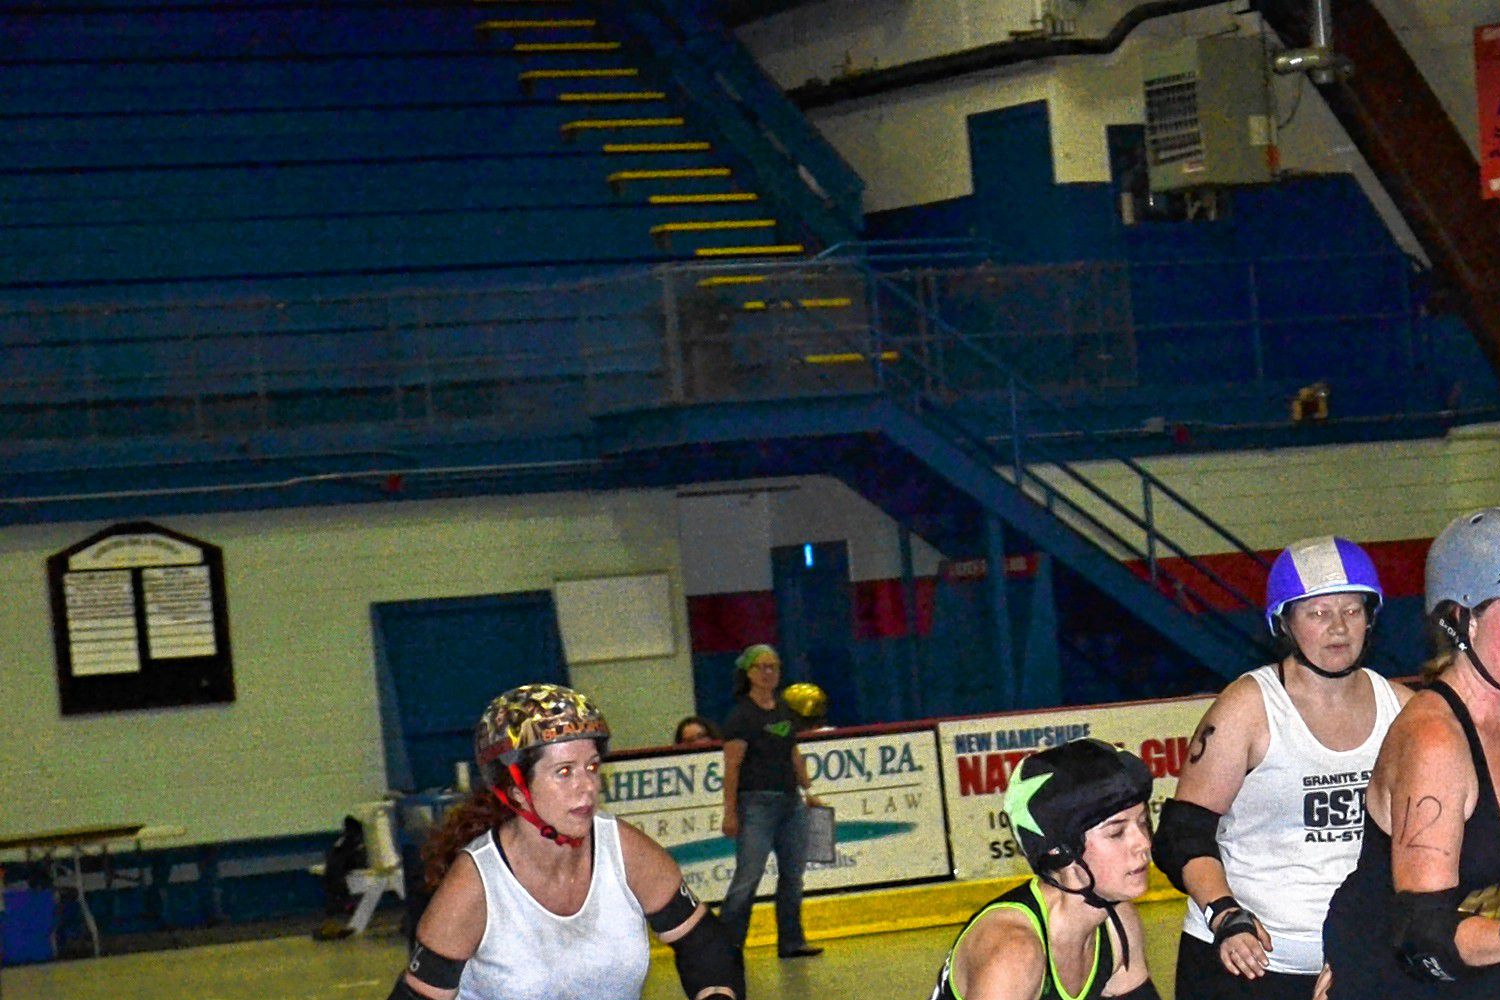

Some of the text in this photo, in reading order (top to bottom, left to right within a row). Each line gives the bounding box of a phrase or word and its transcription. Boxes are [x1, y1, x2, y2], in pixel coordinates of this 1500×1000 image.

[954, 732, 992, 754] NEW
[1303, 771, 1358, 786] GRANITE
[861, 792, 924, 816] LAW
[1399, 795, 1450, 857] 12
